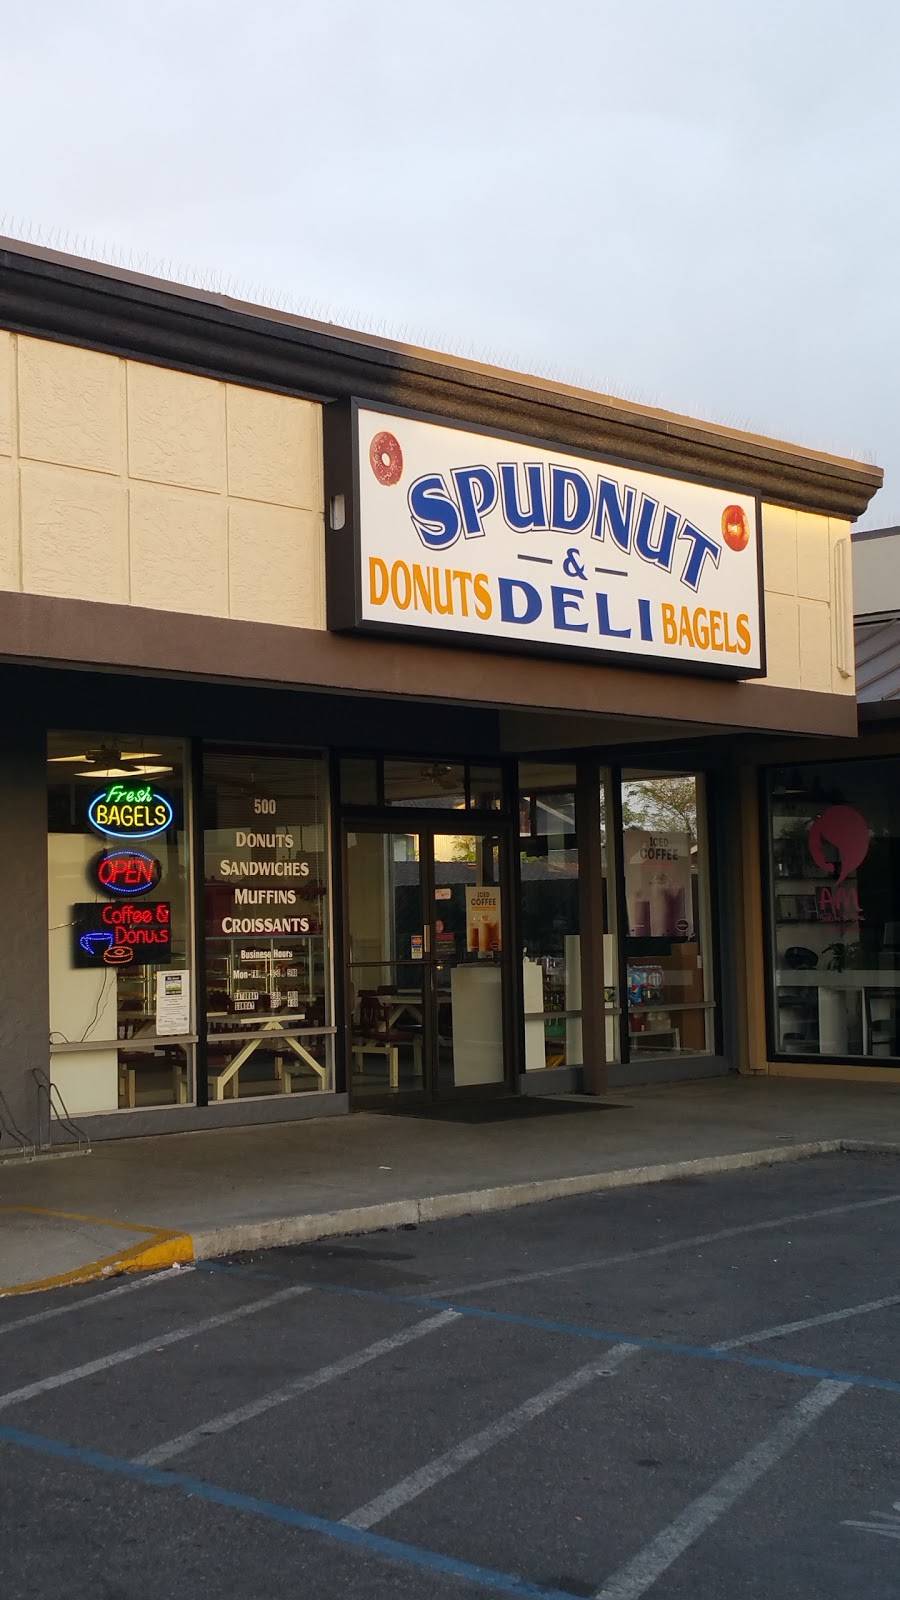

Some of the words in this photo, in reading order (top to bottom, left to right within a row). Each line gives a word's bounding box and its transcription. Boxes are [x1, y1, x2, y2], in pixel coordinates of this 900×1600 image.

[407, 462, 722, 593] SPUDNUT
[562, 548, 589, 581] &
[368, 556, 494, 620] DONUTS
[498, 577, 654, 642] DELI
[661, 603, 751, 656] BAGELS
[105, 785, 153, 803] Fresh
[96, 804, 167, 827] BAGELS
[254, 799, 277, 815] 500
[235, 831, 294, 849] DONUTS
[649, 837, 669, 847] ICED
[640, 848, 679, 861] COFFEE
[97, 859, 155, 884] OPEN
[220, 859, 310, 877] SANDWICHES
[234, 888, 297, 905] MUFFINS
[470, 898, 497, 906] COFFEE
[102, 905, 152, 924] Coffee
[156, 904, 169, 923] &
[221, 916, 310, 934] CROISSANTS
[240, 949, 272, 960] Business
[273, 948, 293, 959] Hours
